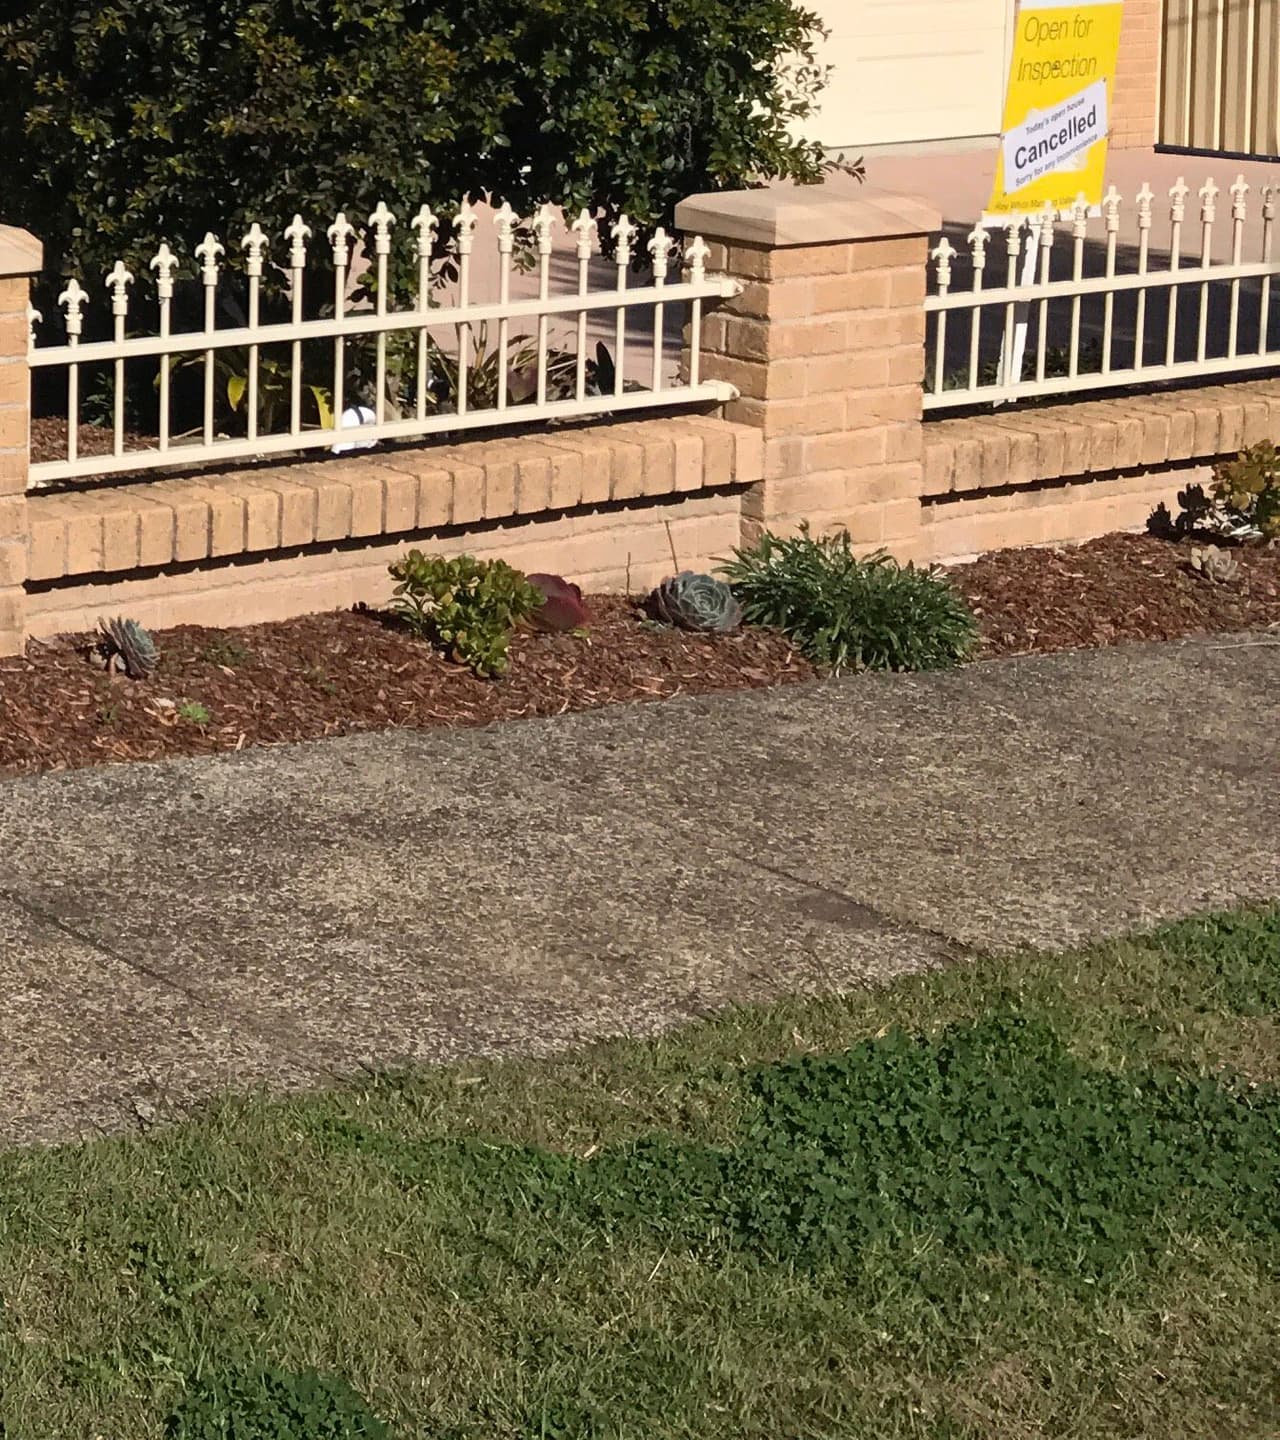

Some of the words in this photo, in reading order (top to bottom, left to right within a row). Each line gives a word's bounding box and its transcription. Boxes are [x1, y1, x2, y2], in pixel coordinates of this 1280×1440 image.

[1024, 16, 1069, 47] Open
[1073, 13, 1094, 39] for
[1017, 56, 1097, 86] Inspection
[1015, 104, 1097, 170] Cancelled
